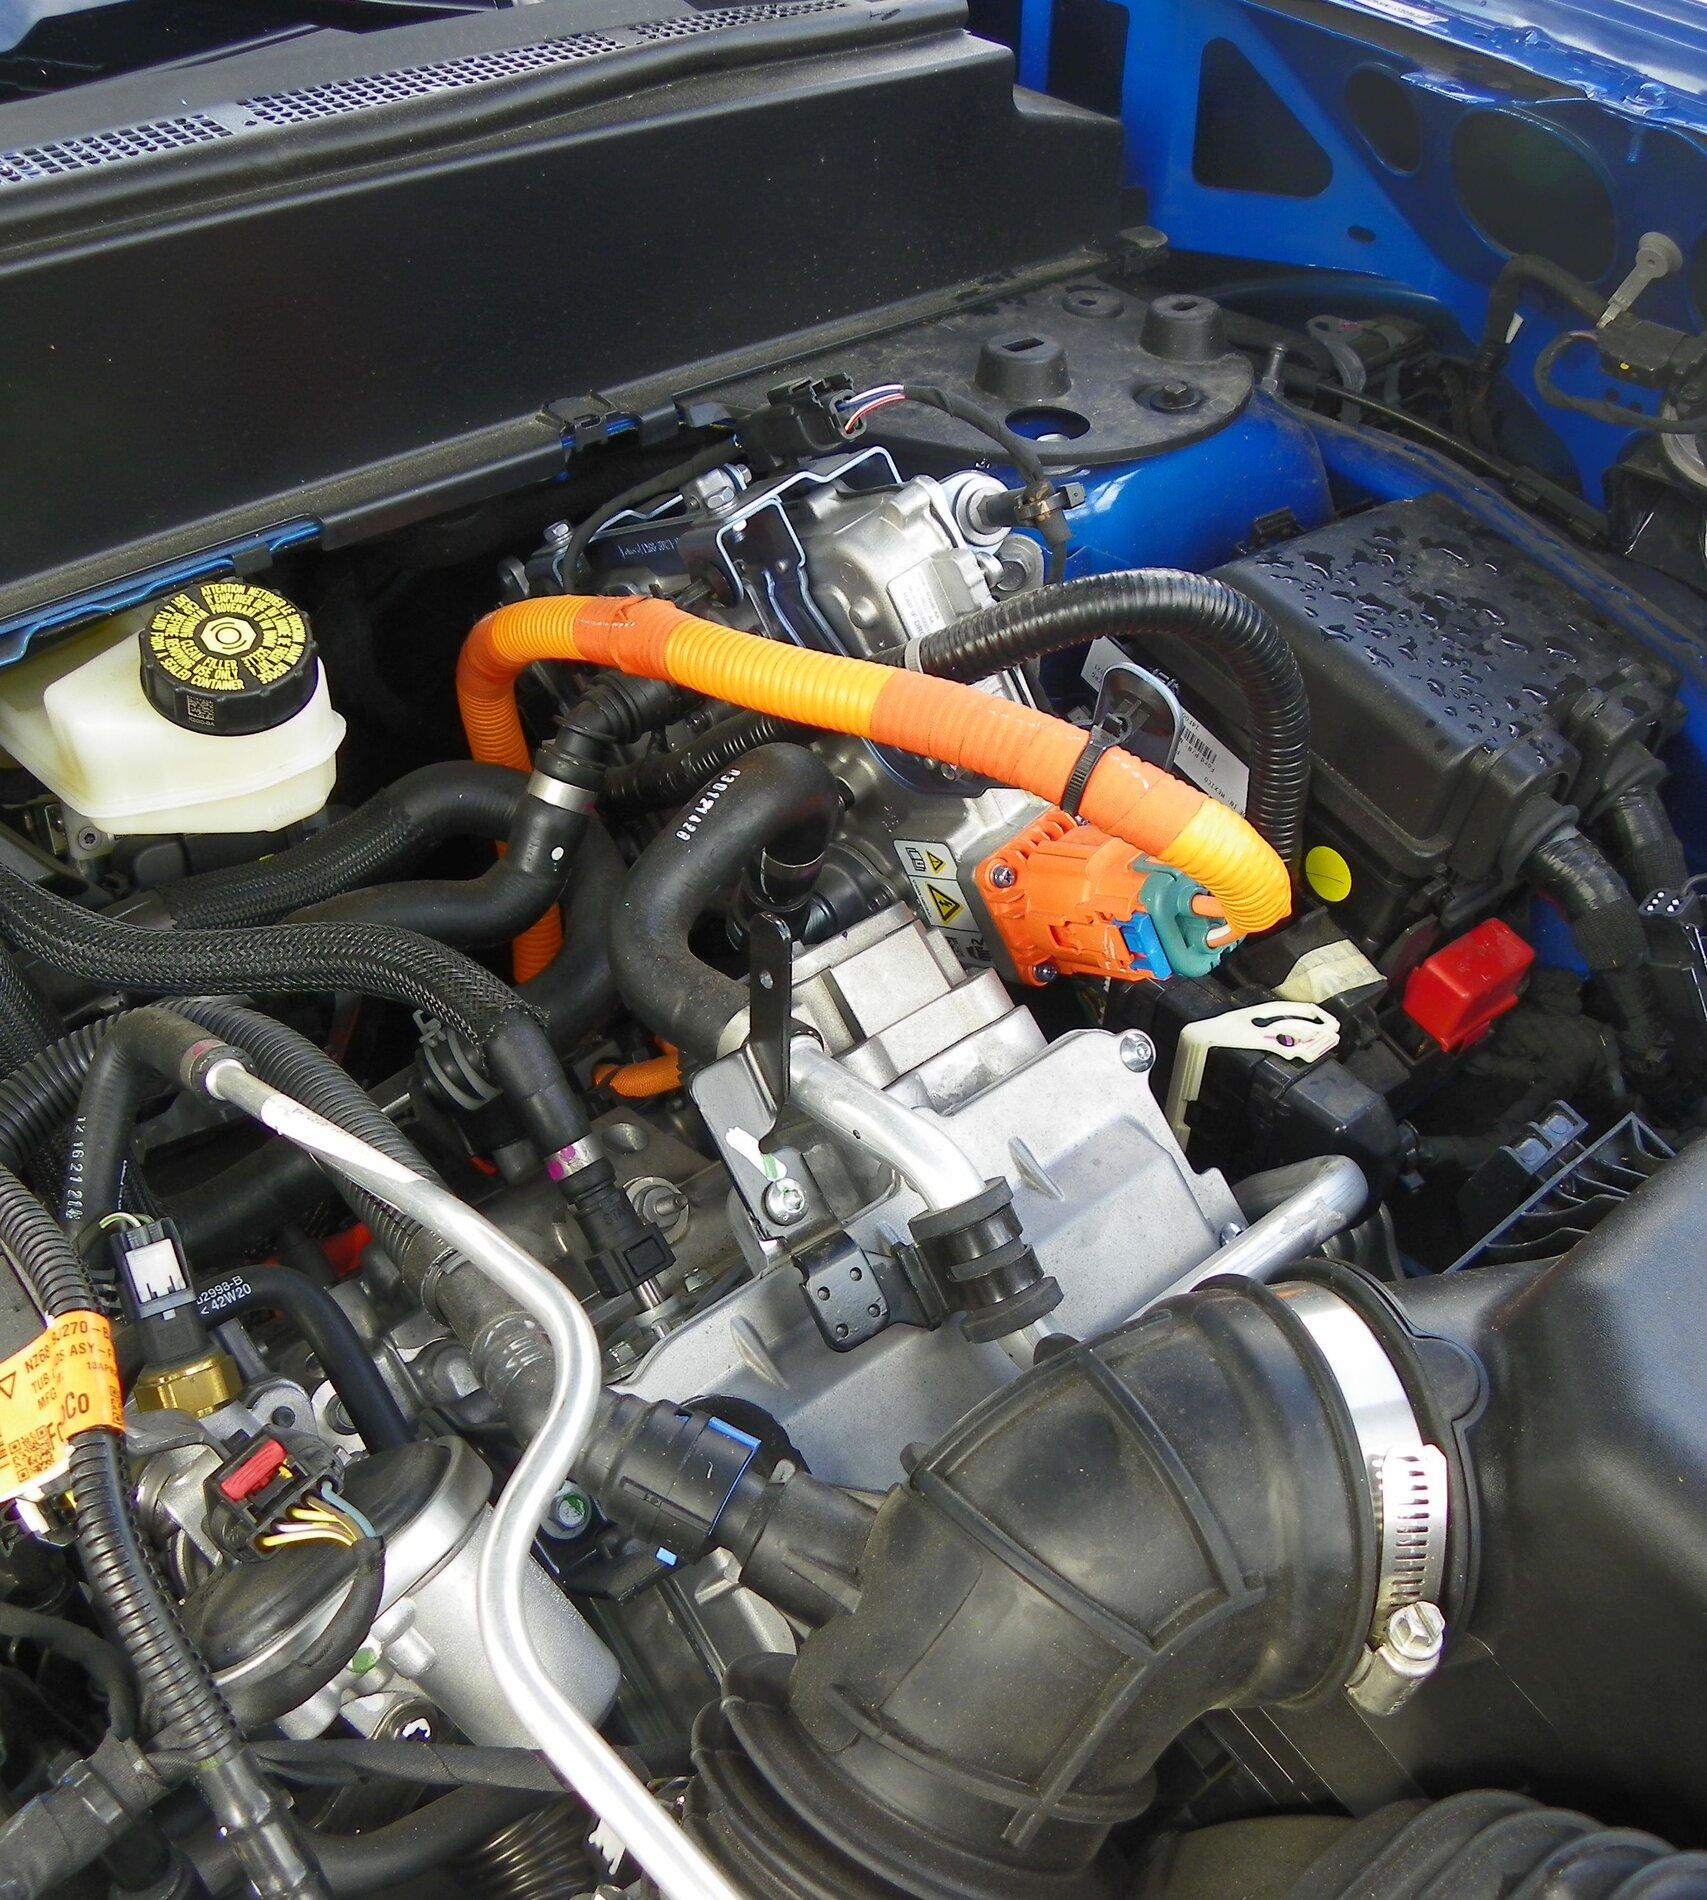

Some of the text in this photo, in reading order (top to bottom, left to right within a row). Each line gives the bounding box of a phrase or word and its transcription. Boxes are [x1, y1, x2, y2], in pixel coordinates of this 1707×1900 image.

[170, 593, 193, 609] DOT
[200, 583, 247, 597] ATTENTION
[151, 610, 174, 631] FLUID
[150, 631, 168, 651] FROM
[164, 600, 241, 681] CAP BEFORE REMOVING USE ONLY
[179, 639, 206, 662] CLEAN
[202, 656, 239, 672] FILLER
[159, 657, 193, 681] SEALED
[190, 674, 245, 691] CONTAINER
[1203, 776, 1226, 799] MEXICO
[211, 1283, 252, 1310] 42W20
